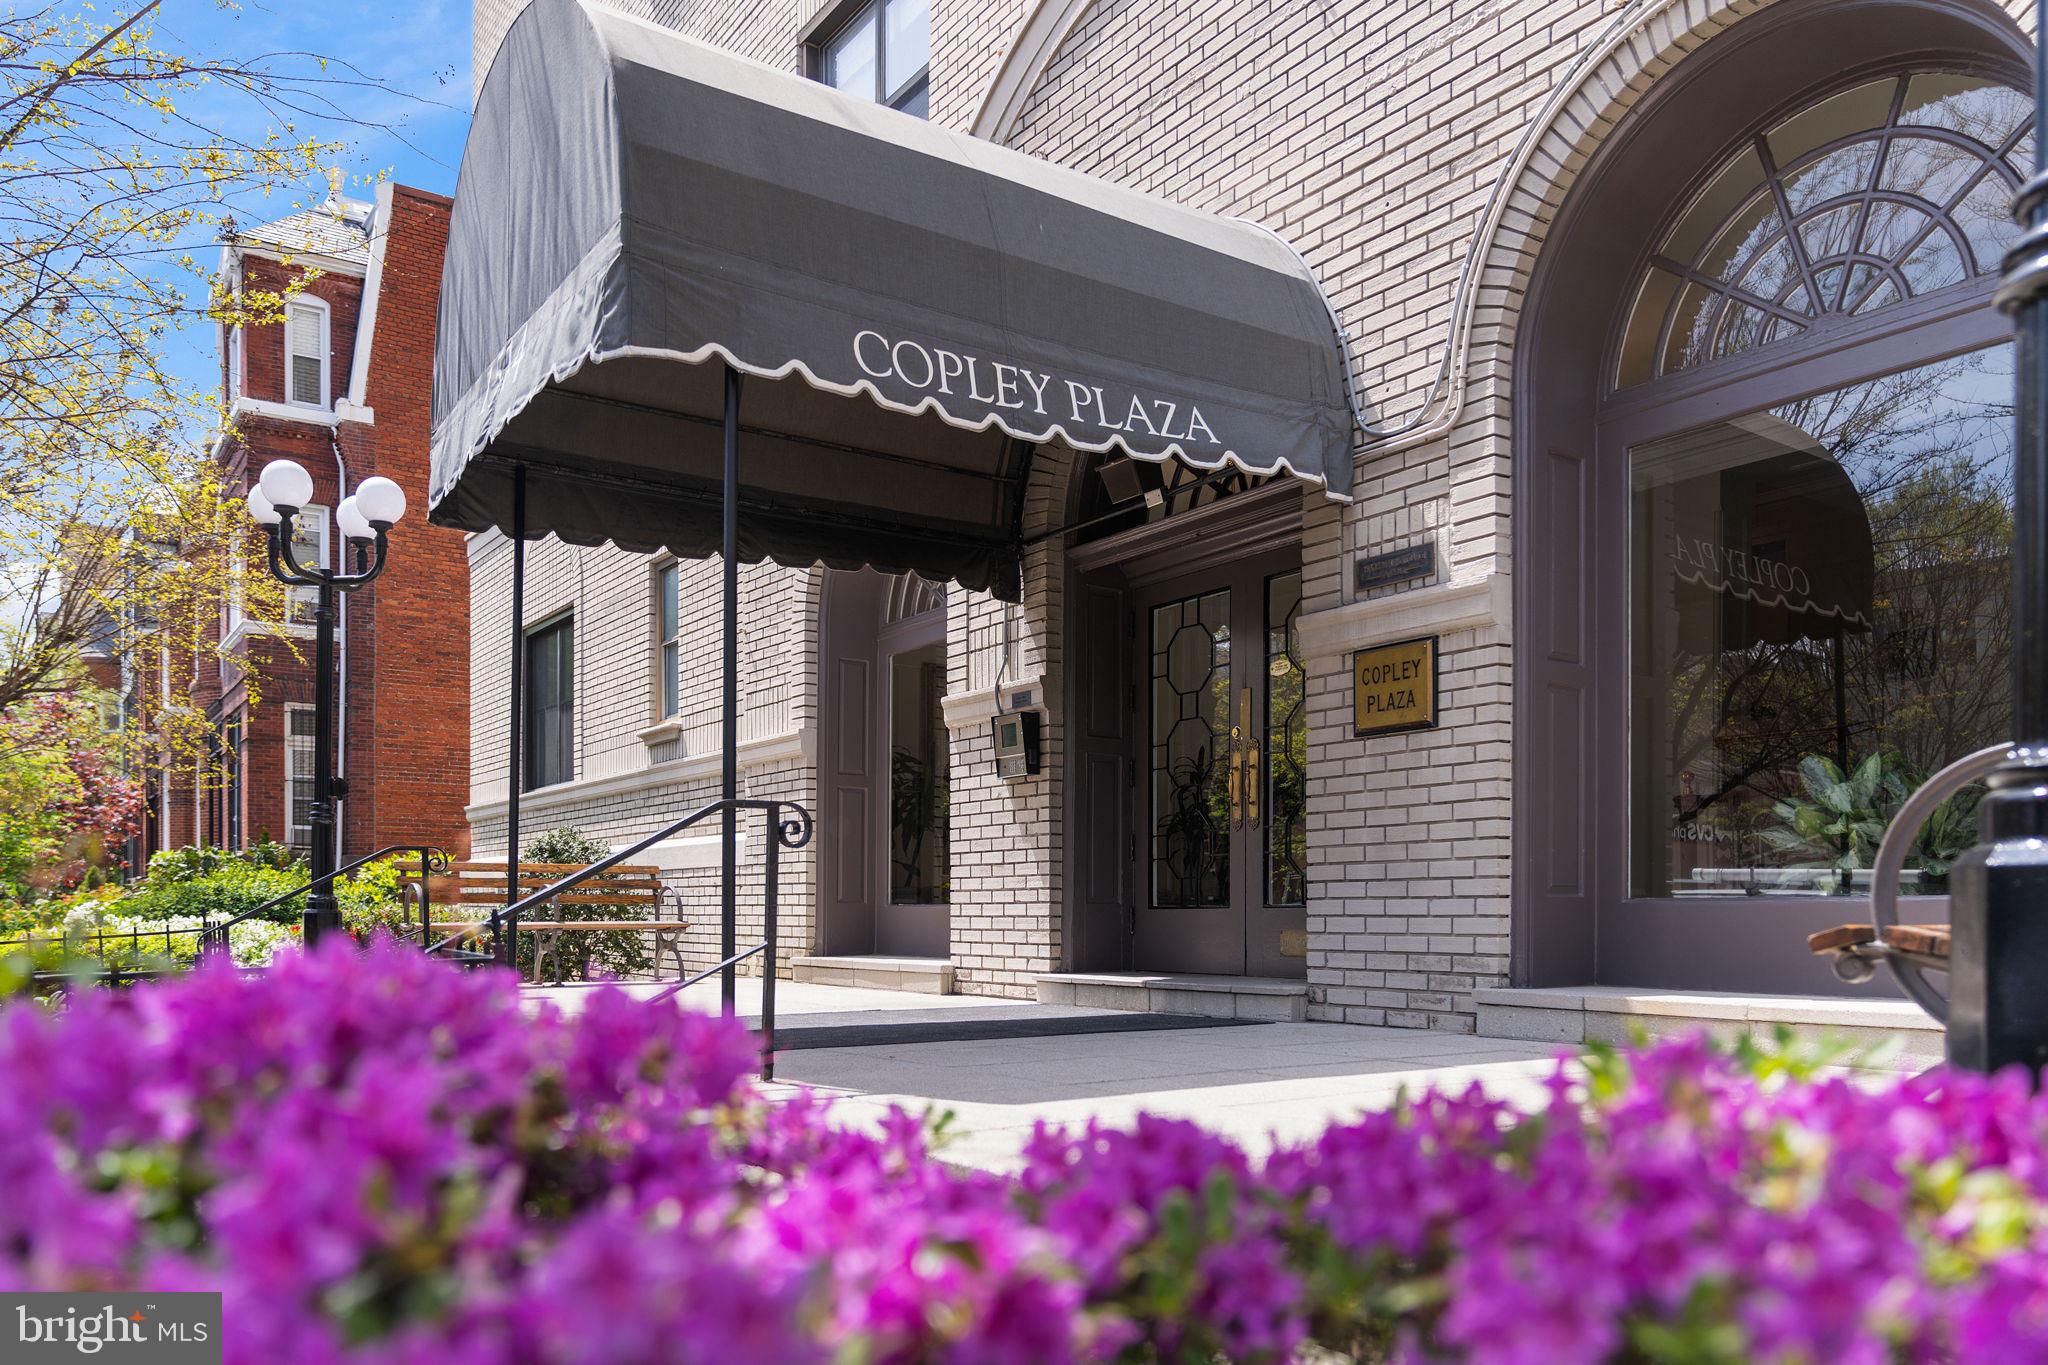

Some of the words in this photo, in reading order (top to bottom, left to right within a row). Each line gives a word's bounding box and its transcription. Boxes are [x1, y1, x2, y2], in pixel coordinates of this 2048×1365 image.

[853, 330, 1051, 415] COPLEY
[1064, 379, 1221, 444] PLAZA
[1362, 659, 1421, 686] COPLEY
[1367, 690, 1416, 713] PLAZA
